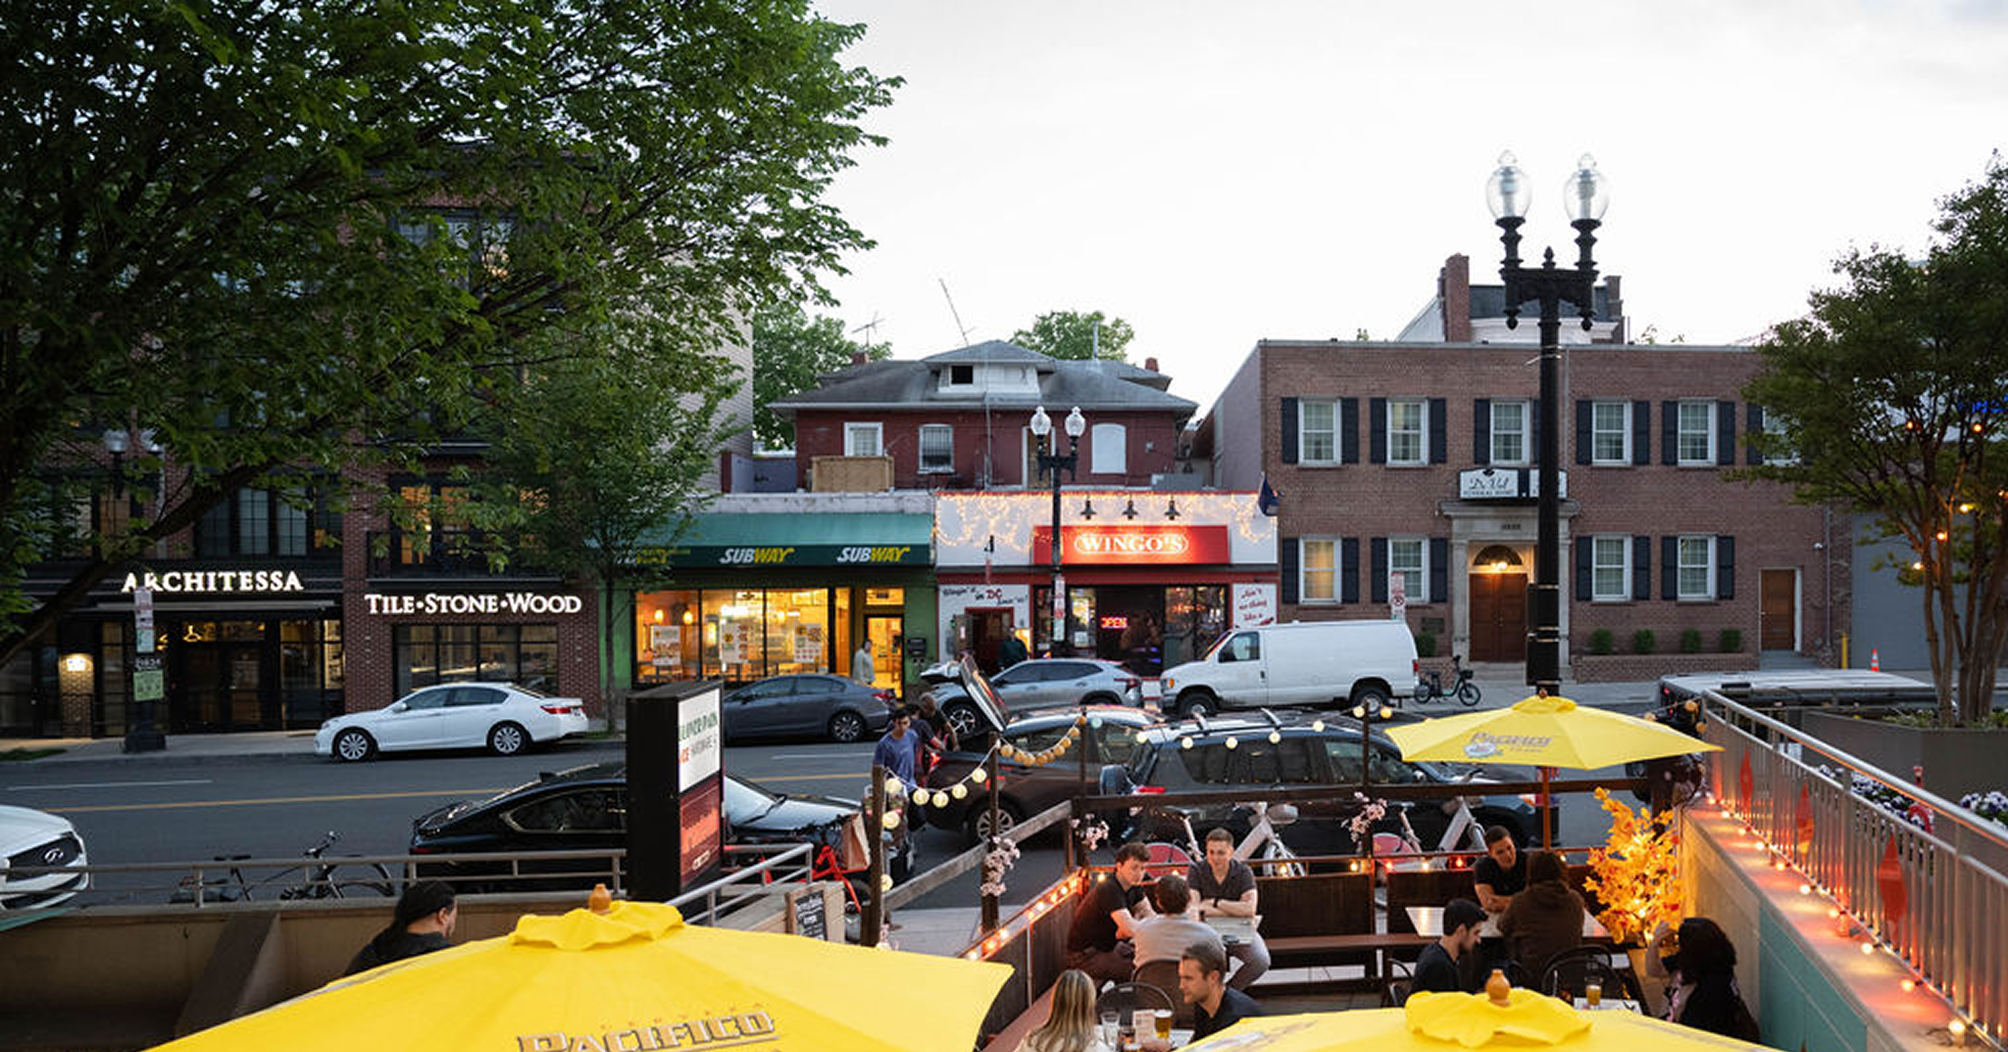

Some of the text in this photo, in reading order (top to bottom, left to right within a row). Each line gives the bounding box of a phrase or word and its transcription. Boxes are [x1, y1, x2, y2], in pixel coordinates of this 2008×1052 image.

[1081, 533, 1183, 552] WINGO'S
[720, 547, 795, 564] SUBWAY
[837, 547, 911, 563] SUBWAY
[121, 571, 304, 593] ARCHITESSA
[1101, 617, 1128, 628] OPEN
[518, 1011, 775, 1052] PACIFICO
